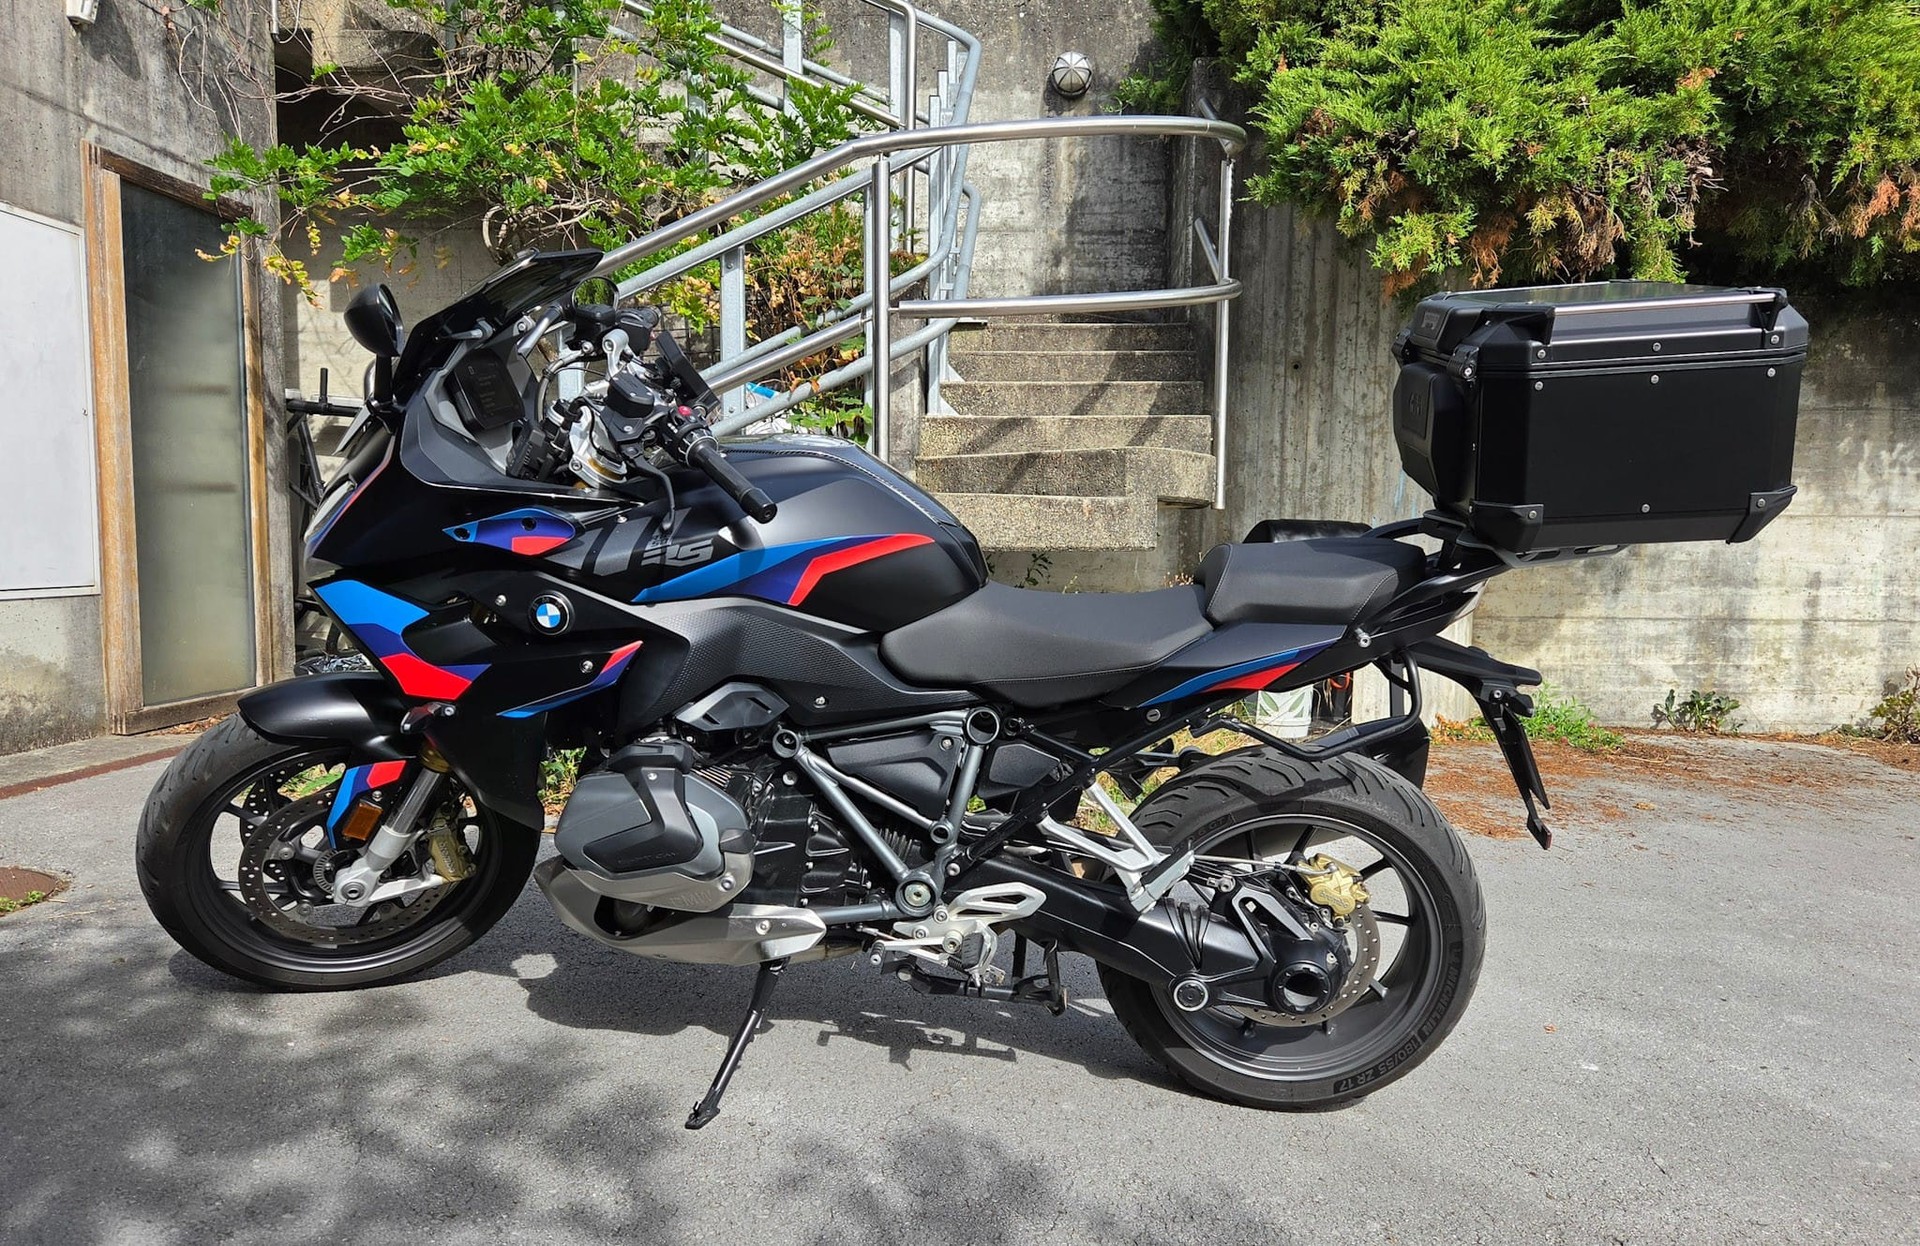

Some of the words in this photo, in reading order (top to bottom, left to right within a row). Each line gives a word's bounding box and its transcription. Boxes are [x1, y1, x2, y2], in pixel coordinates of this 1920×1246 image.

[641, 538, 713, 567] RS
[1423, 966, 1460, 1036] MICHELIN
[1379, 1038, 1421, 1075] 180/55
